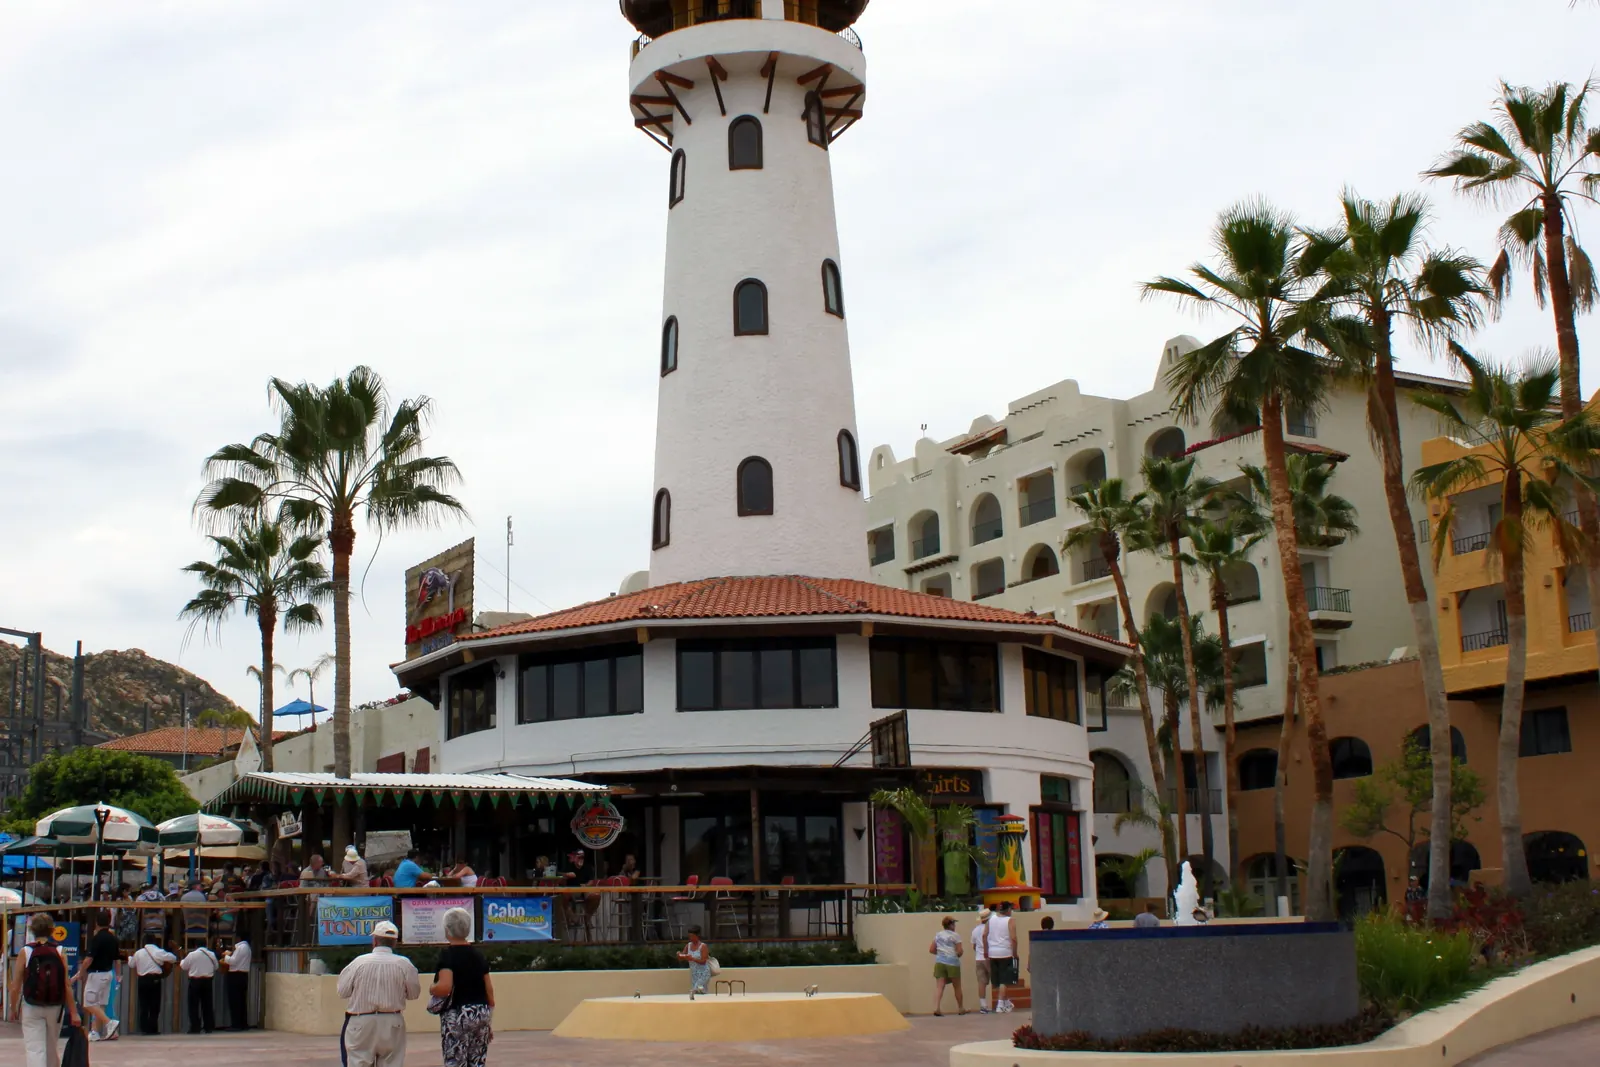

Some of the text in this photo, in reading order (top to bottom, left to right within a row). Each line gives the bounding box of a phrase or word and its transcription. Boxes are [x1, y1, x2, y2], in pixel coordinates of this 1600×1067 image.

[319, 905, 391, 919] LIVE MUSIC
[487, 902, 526, 918] Cabo
[320, 919, 384, 937] TONIT
